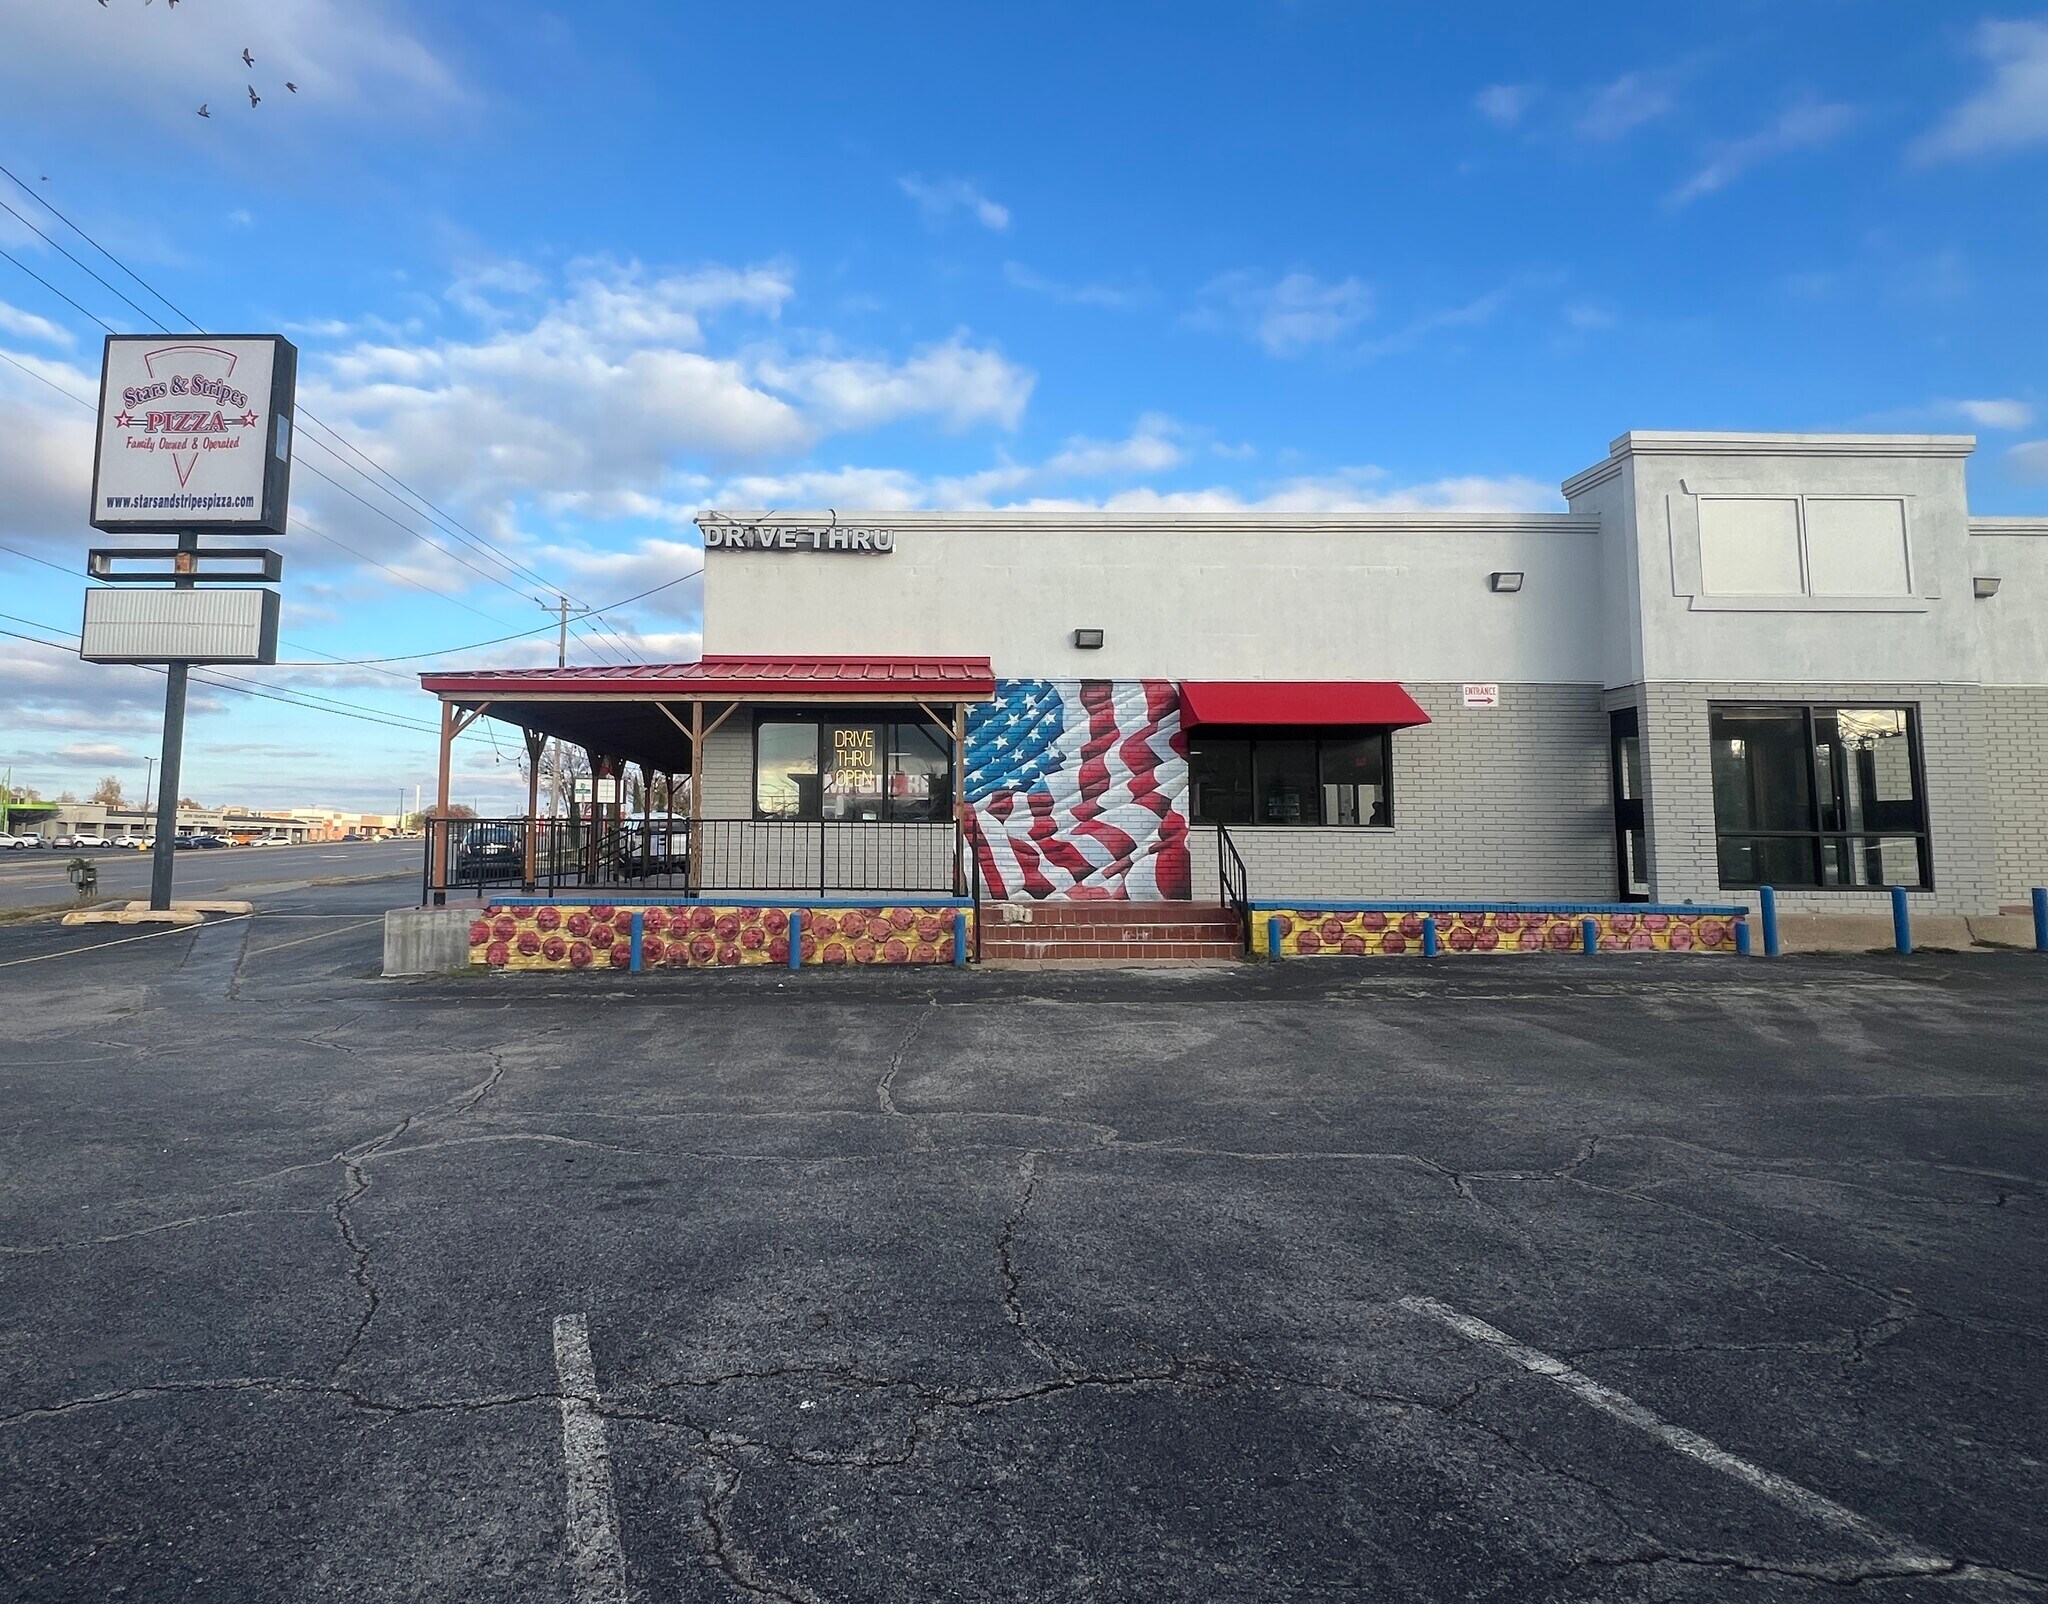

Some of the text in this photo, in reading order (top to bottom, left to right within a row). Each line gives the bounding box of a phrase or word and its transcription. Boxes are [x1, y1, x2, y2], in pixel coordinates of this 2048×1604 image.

[123, 374, 248, 409] Stars & Stripes
[145, 411, 228, 433] PIZZA
[126, 436, 240, 452] Family Owned & Operated
[106, 493, 254, 511] www.starsandstripespizza.com
[704, 525, 895, 551] DRIVE THRU
[1464, 686, 1497, 696] ENTRANCE
[834, 730, 874, 748] DRIVE
[836, 750, 873, 767] THRU
[835, 770, 873, 787] OPEN
